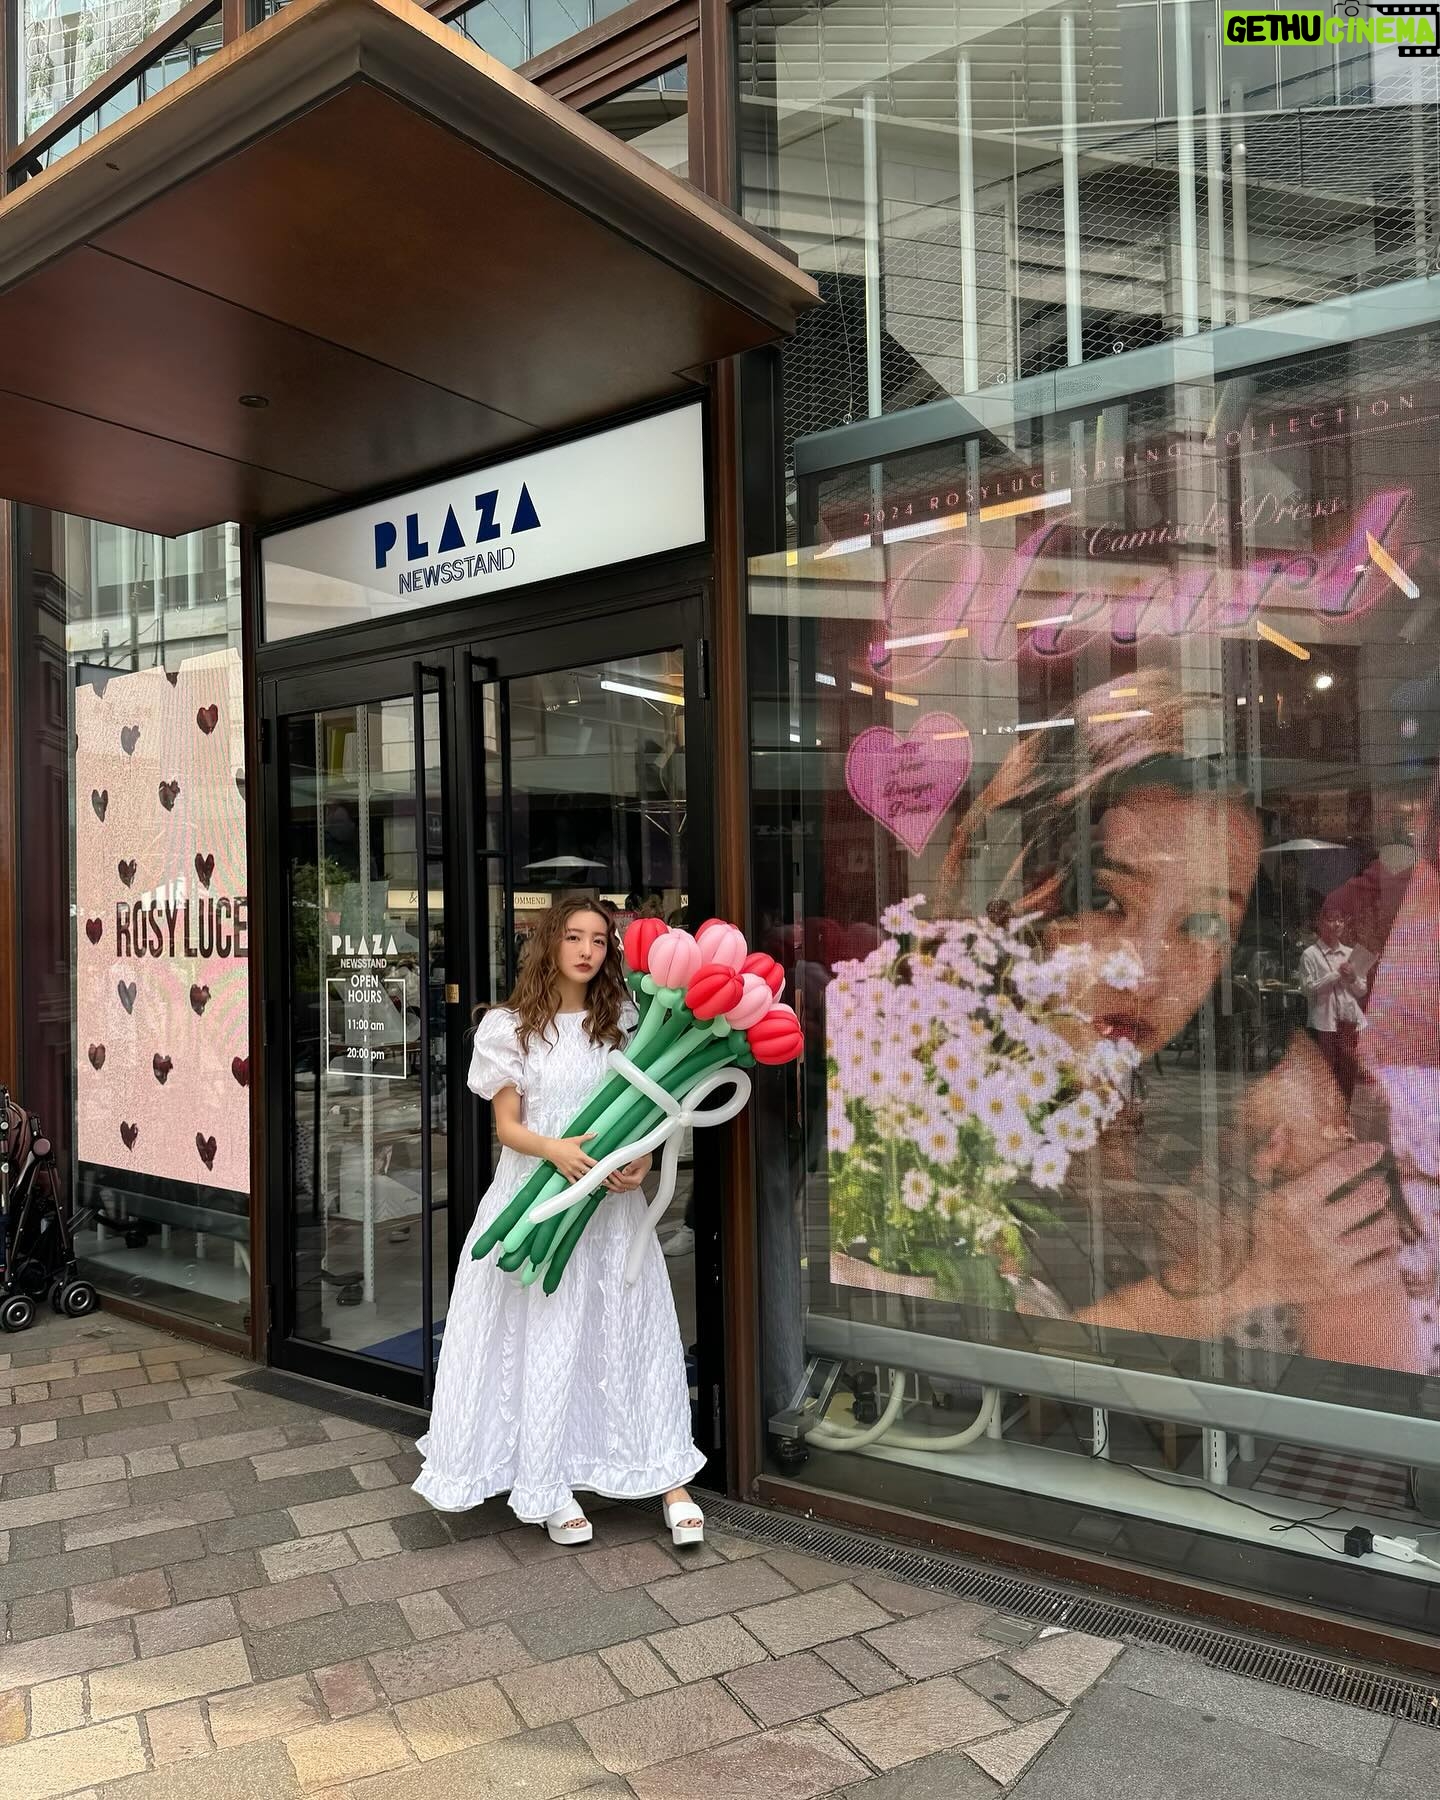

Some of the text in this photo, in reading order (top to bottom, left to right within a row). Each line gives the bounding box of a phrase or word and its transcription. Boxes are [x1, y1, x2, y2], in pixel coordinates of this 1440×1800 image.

[863, 503, 913, 527] 2024
[1080, 443, 1182, 480] SPRING
[373, 481, 541, 569] PLAZA
[398, 546, 516, 595] NEWSSTAND
[514, 896, 546, 905] OMMEND
[331, 934, 398, 956] PLAZA
[340, 958, 387, 969] NEWSSTAND
[350, 974, 379, 988] OPEN
[347, 989, 382, 1004] HOURS
[347, 1019, 384, 1031] 11:00 am
[346, 1047, 385, 1062] 20:00 pm
